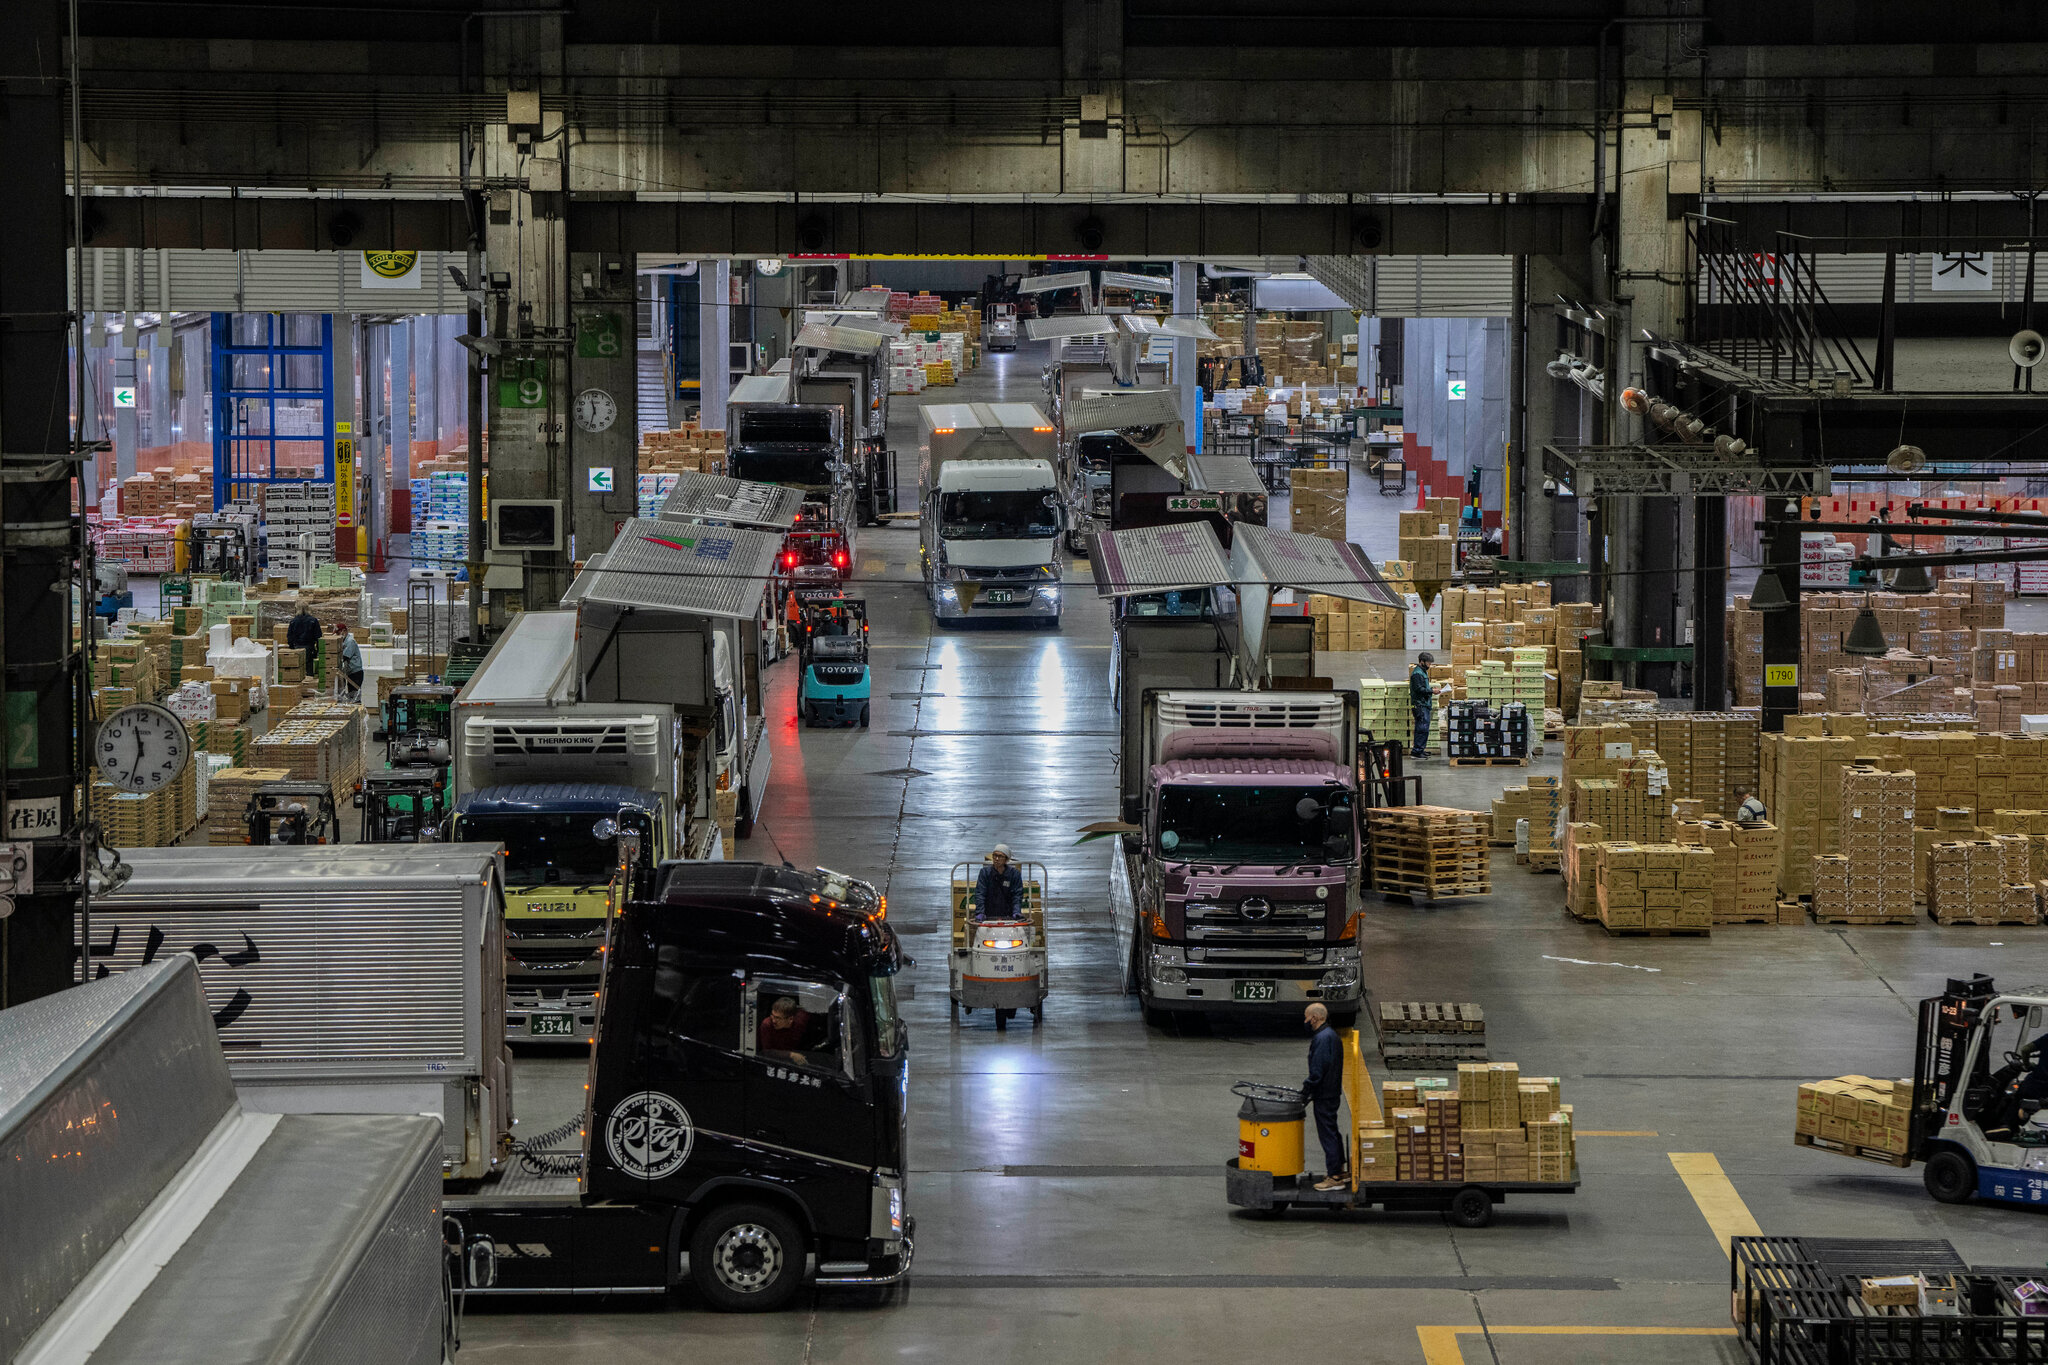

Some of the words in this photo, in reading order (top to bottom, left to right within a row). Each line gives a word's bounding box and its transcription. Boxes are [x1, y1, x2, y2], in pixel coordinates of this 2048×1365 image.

[597, 332, 619, 355] 8
[519, 377, 543, 405] 9
[821, 666, 859, 674] TOYOTA
[1770, 670, 1793, 681] 1790
[120, 718, 131, 727] 11
[136, 713, 149, 723] 12
[156, 718, 160, 727] 1
[109, 729, 122, 738] 10
[164, 730, 174, 740] 2
[12, 724, 34, 764] 2
[538, 737, 573, 745] THERMO
[573, 736, 594, 744] KING
[103, 742, 114, 752] 9
[168, 746, 178, 756] 3
[107, 758, 117, 767] 8
[162, 761, 173, 770] 4
[120, 771, 129, 780] 7
[134, 776, 144, 785] 6
[151, 772, 161, 781] 5
[526, 902, 577, 912] ISUZU
[1243, 986, 1274, 999] 12-97
[538, 1020, 572, 1034] 33-44
[656, 1099, 675, 1113] COLD
